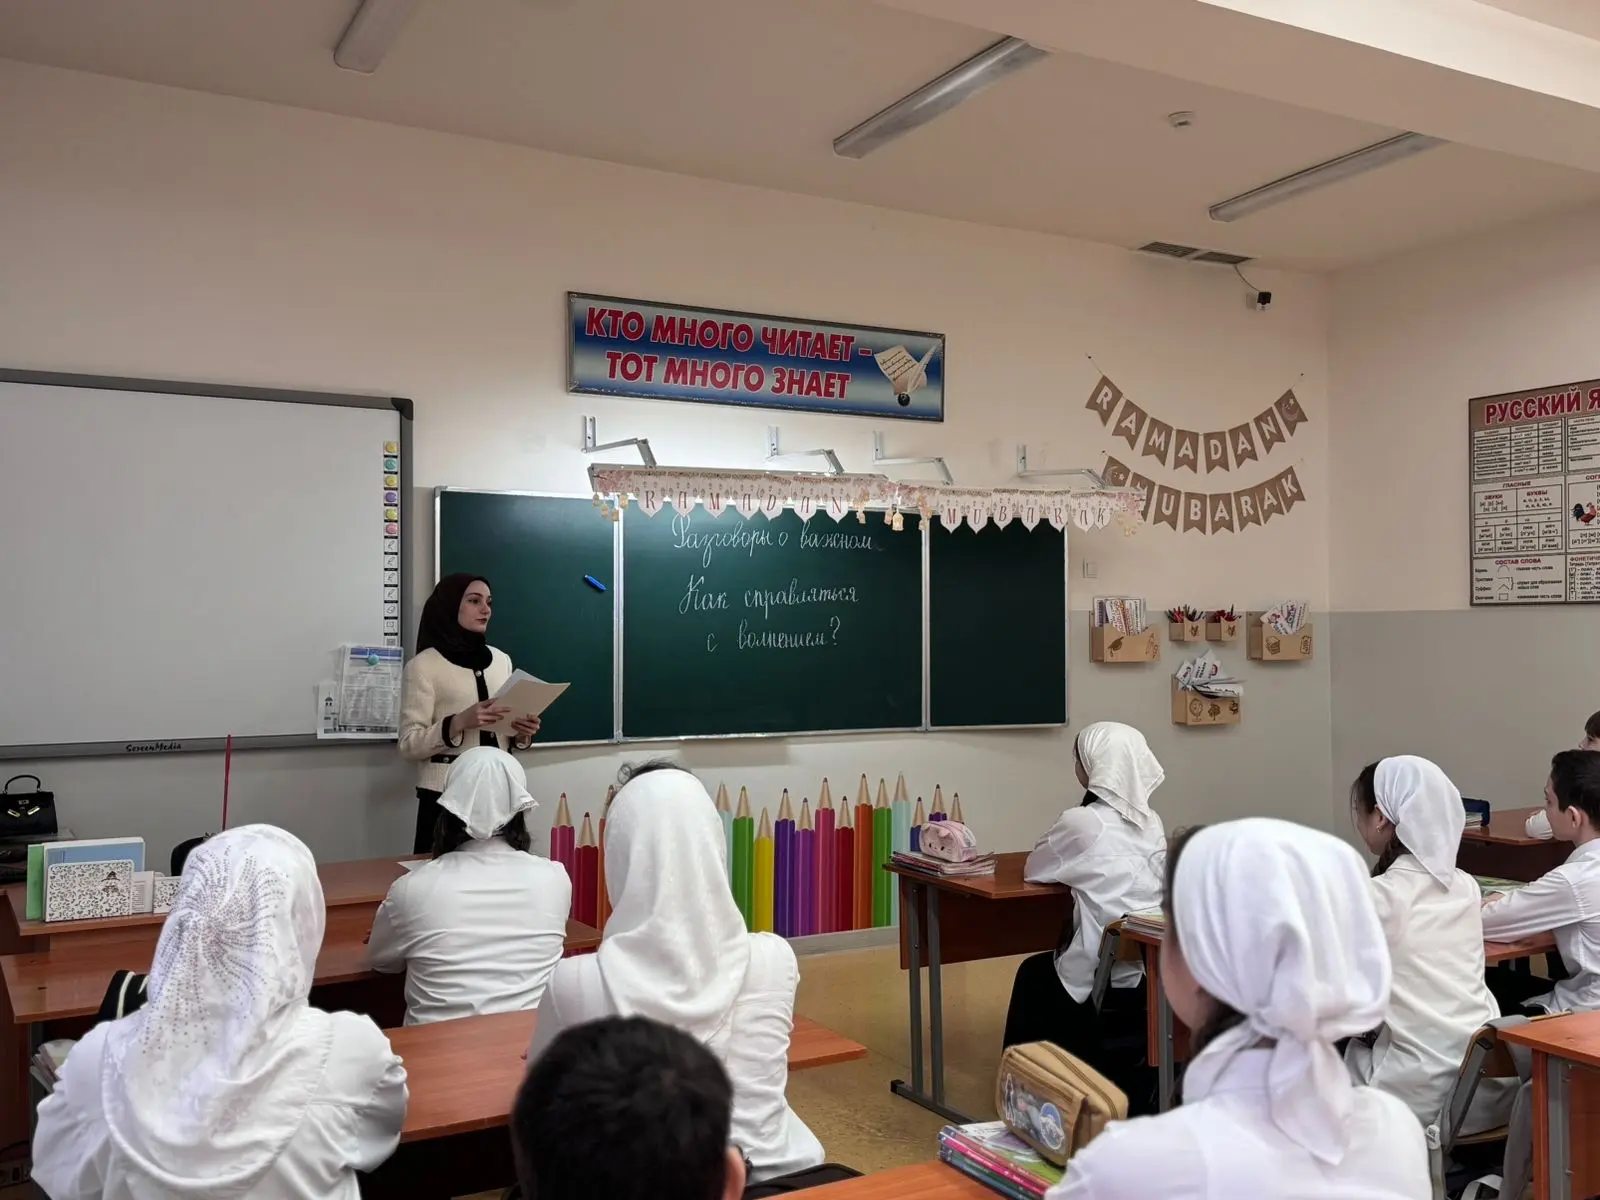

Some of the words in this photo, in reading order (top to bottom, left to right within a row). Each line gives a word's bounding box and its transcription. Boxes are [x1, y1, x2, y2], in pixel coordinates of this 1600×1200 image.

[586, 306, 645, 341] КТО
[650, 312, 755, 352] МНОГО
[760, 325, 855, 362] ЧИТАЕТ
[606, 350, 658, 382] ТОТ
[663, 356, 765, 393] МНОГО
[771, 367, 851, 400] ЗНАЕТ
[1095, 384, 1279, 460] RAMADAN
[1485, 386, 1581, 425] РУССКИЙ
[644, 489, 842, 515] RAMADAN
[672, 512, 774, 568] Разговоры
[778, 531, 789, 547] о
[800, 520, 874, 549] важном
[678, 574, 730, 614] Как
[744, 577, 860, 620] справляться
[707, 632, 719, 652] с
